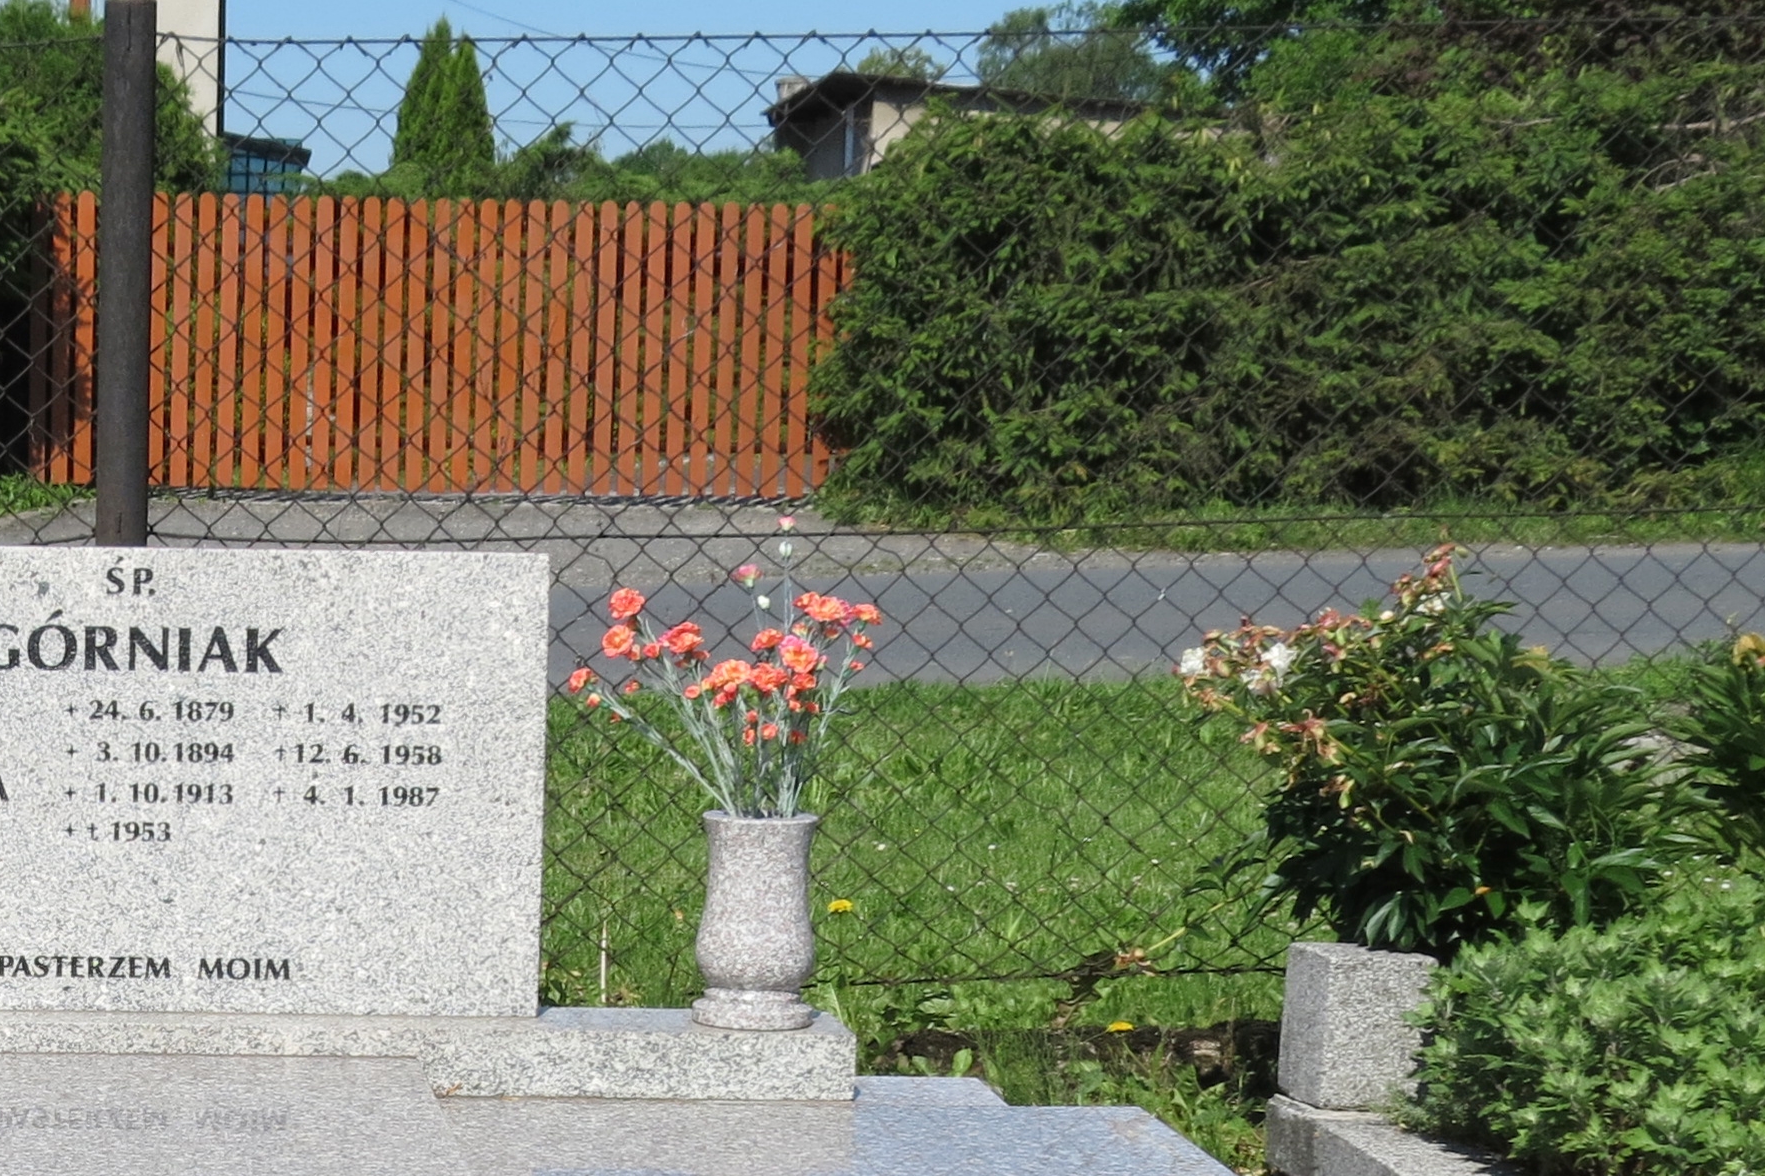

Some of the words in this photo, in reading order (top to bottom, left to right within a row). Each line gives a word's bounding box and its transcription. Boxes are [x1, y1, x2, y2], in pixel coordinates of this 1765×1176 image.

[89, 700, 126, 721] 24.
[173, 701, 234, 723] 1879
[381, 703, 442, 727] 1952
[381, 744, 442, 766] 1958
[379, 786, 440, 808] 1987
[111, 821, 172, 842] 1953
[197, 957, 291, 981] MOIM
